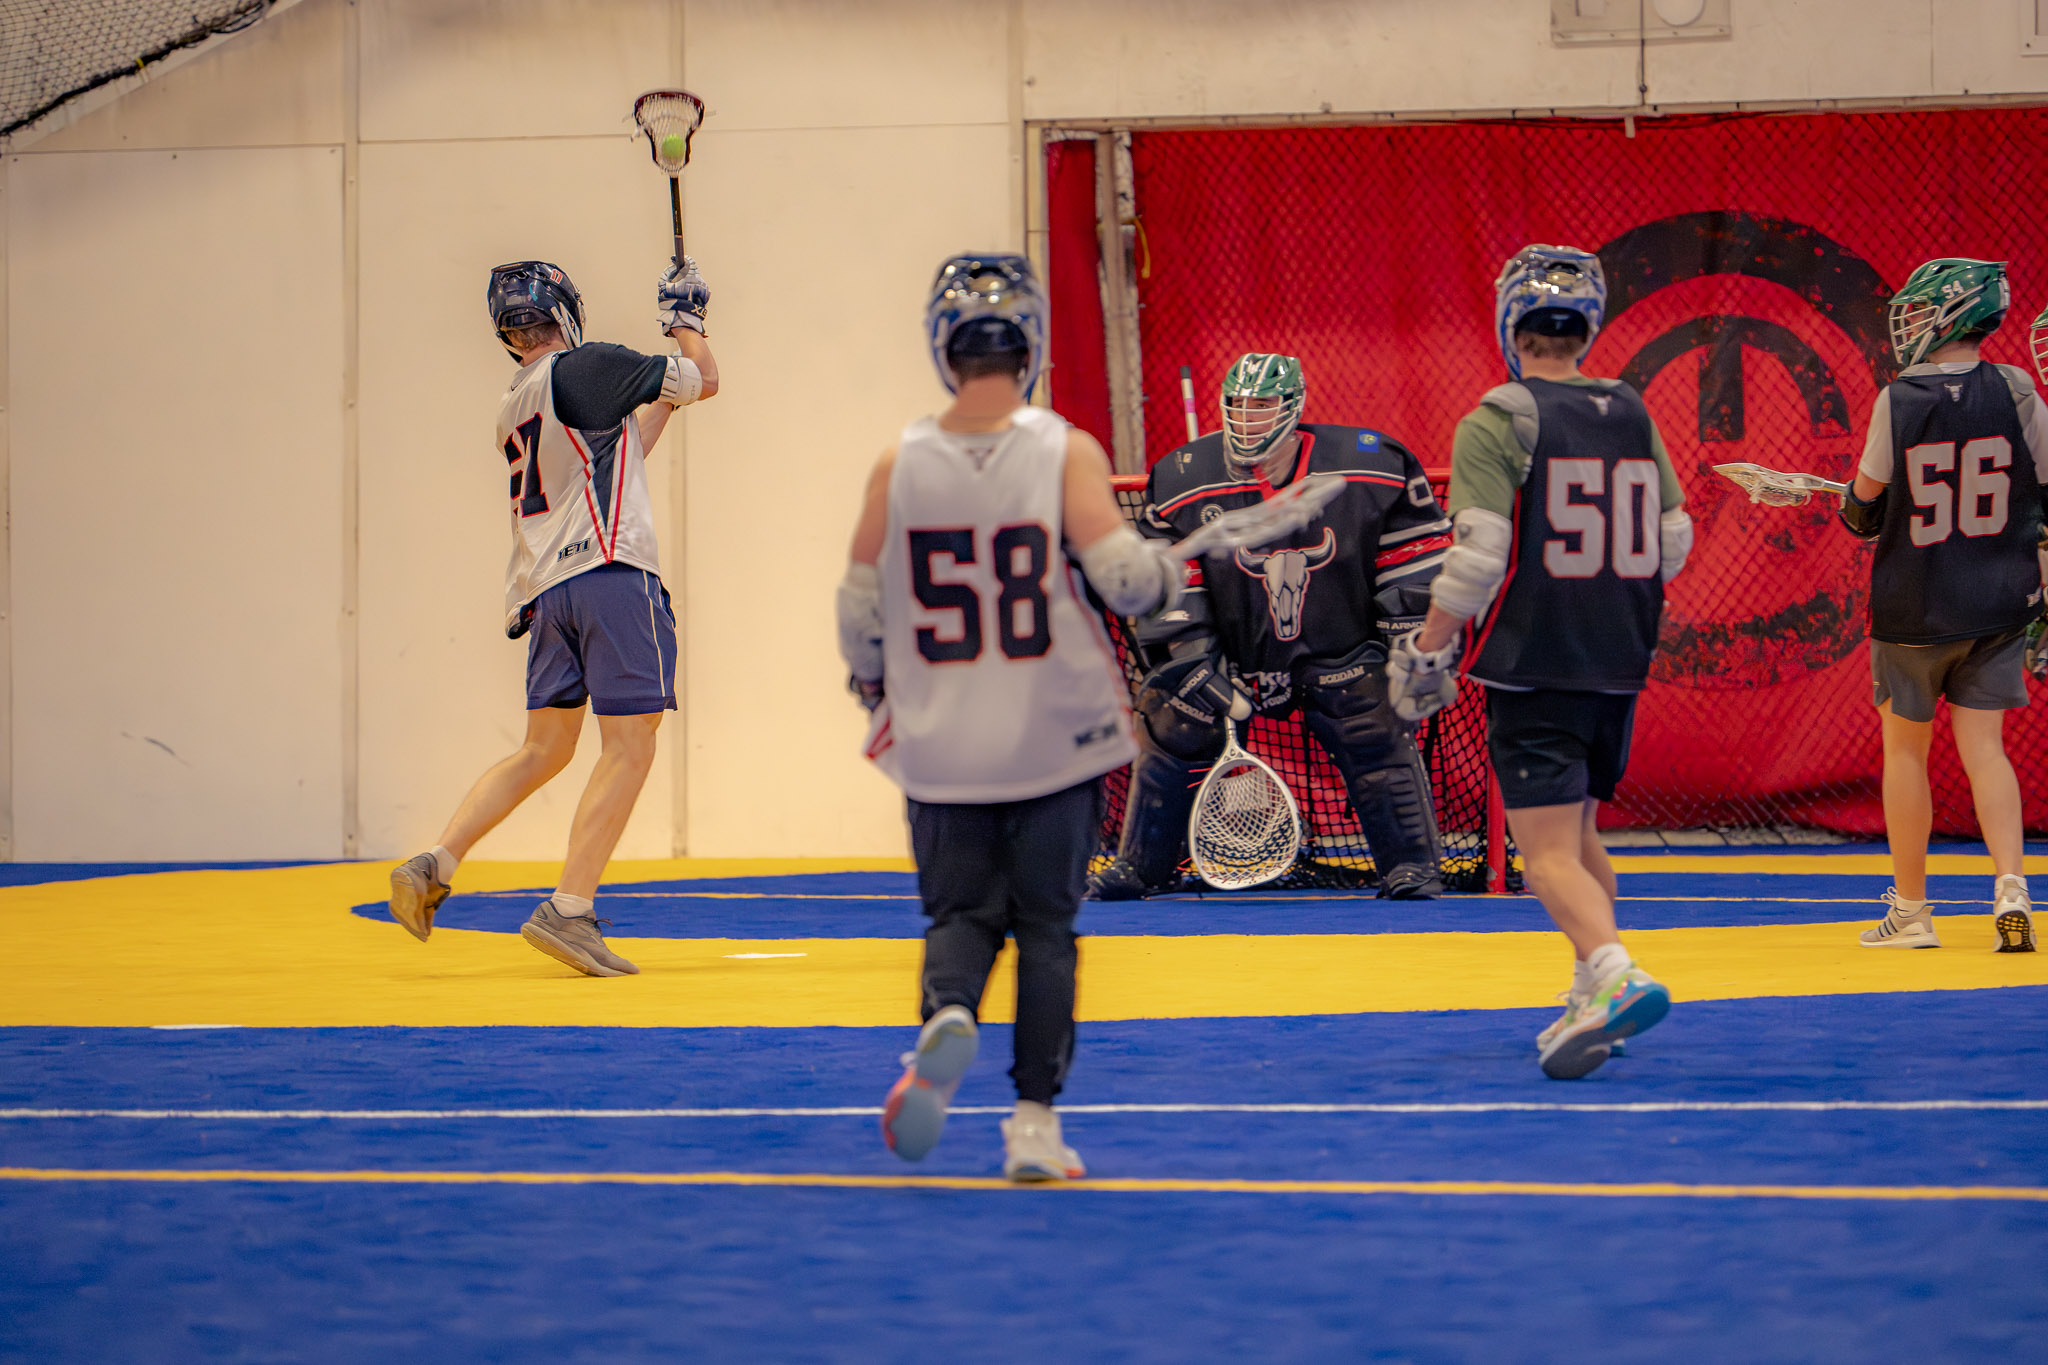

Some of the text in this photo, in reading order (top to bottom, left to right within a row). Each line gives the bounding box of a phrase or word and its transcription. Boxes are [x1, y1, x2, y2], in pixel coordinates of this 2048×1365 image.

[1543, 458, 1661, 579] 50
[1906, 435, 2012, 548] 56
[557, 538, 590, 562] YETI
[908, 523, 1052, 665] 58
[1390, 619, 1426, 631] ARMO
